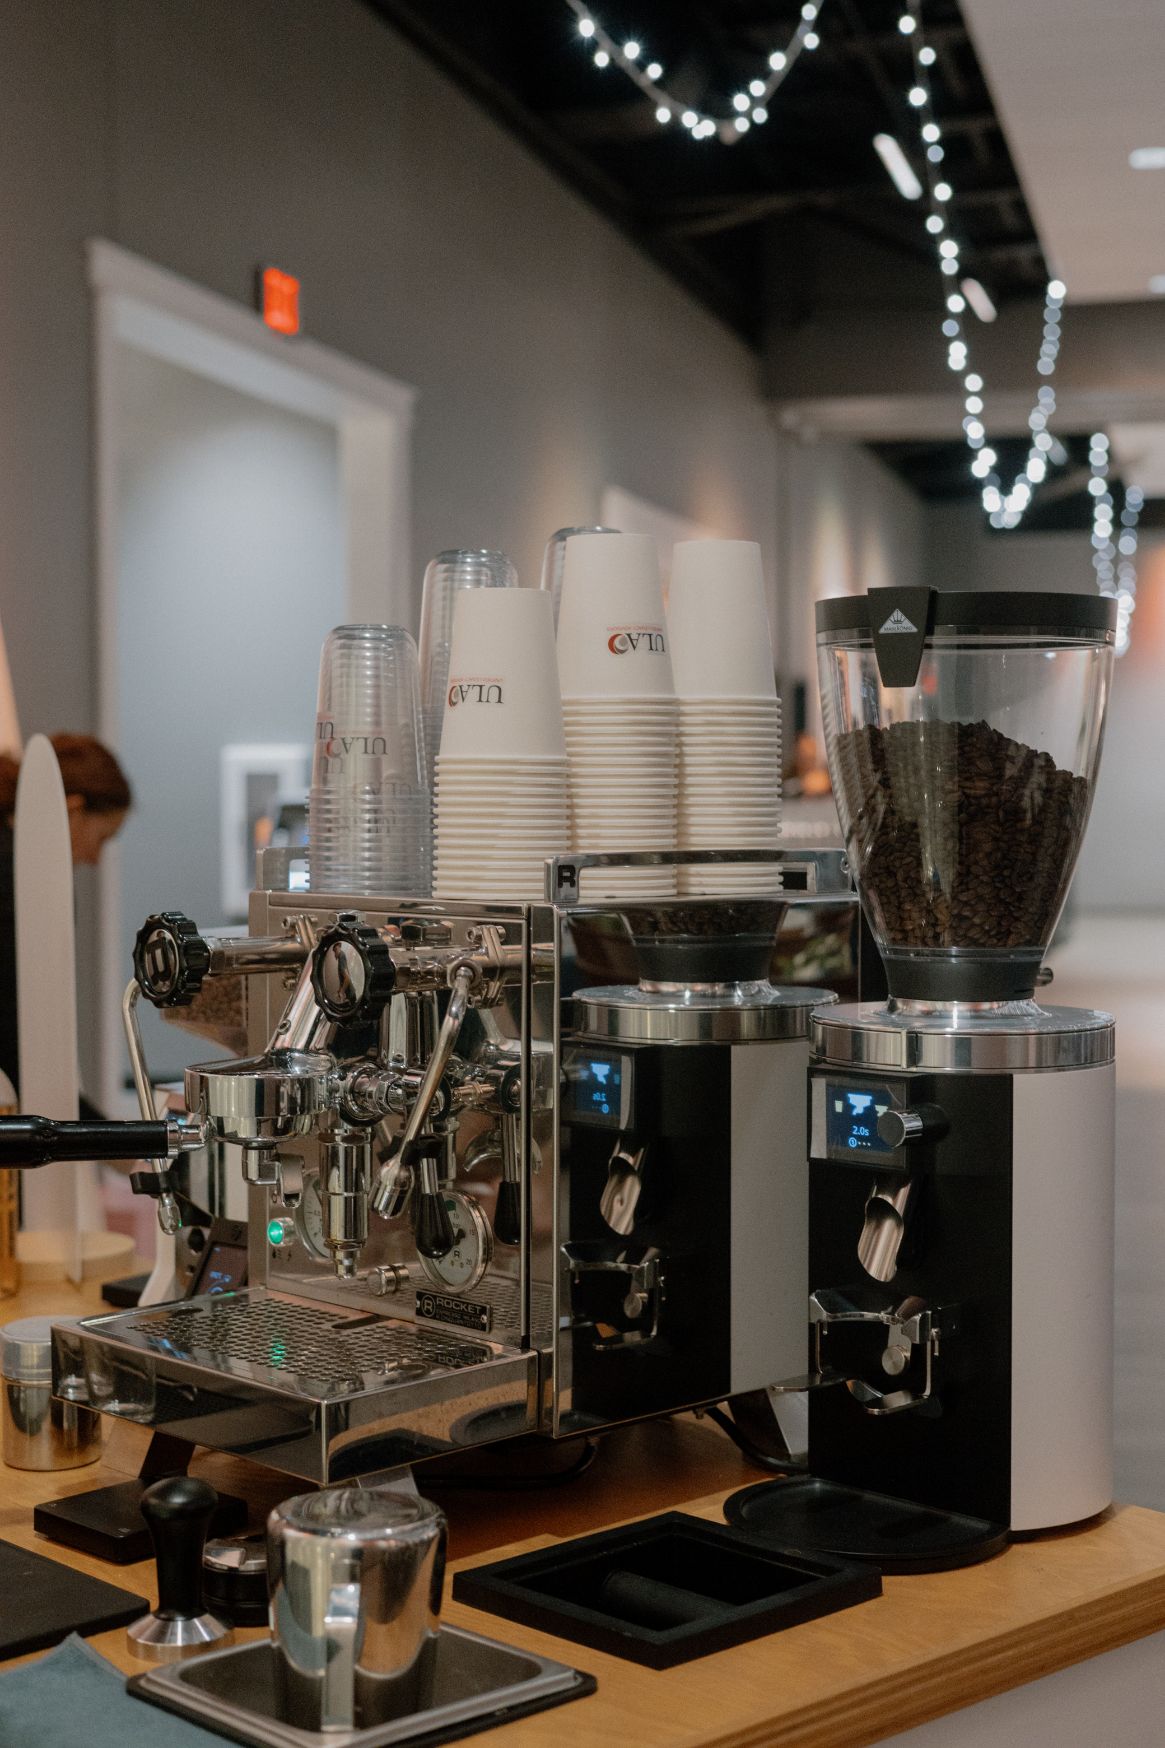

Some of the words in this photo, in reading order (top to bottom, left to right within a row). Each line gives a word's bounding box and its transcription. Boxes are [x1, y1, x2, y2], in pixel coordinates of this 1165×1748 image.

[558, 864, 576, 889] R
[852, 1125, 870, 1136] 2.0s
[436, 1297, 482, 1315] ROCKET
